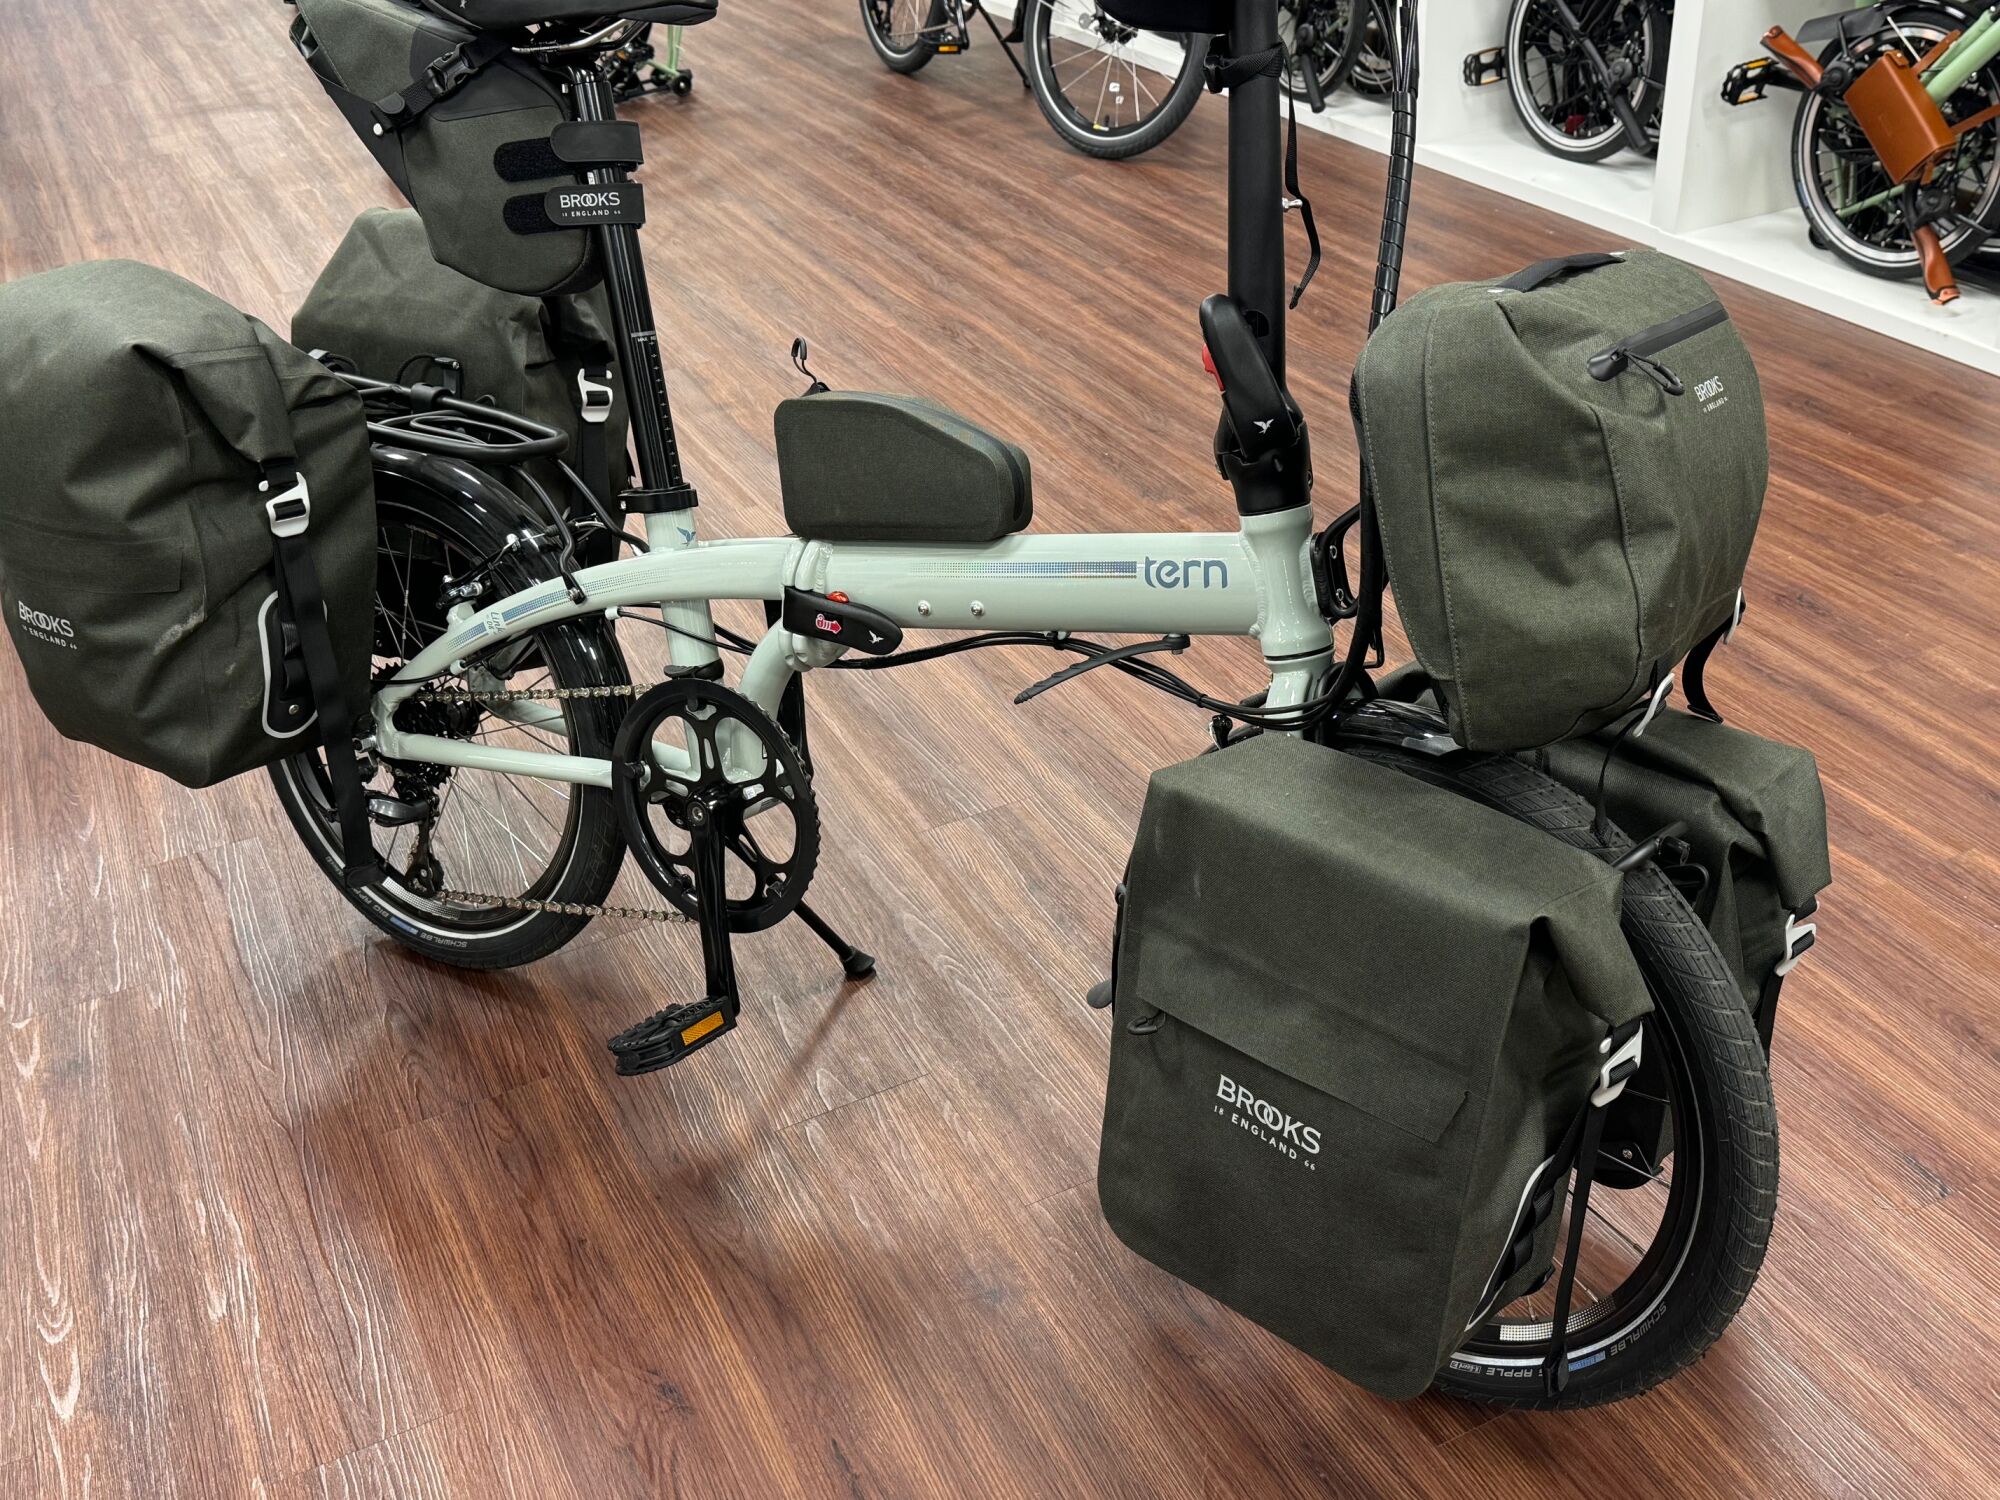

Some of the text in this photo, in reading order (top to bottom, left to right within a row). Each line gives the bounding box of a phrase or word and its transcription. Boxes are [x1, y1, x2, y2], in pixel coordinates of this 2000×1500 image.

[560, 192, 620, 208] BROOKS
[571, 209, 610, 217] ENGLAND
[1693, 375, 1724, 402] BROOKS
[1144, 556, 1228, 589] tern
[18, 600, 74, 637] BROOKS
[491, 611, 506, 633] Link
[29, 627, 67, 647] ENGLAND
[420, 932, 468, 948] SCHWALBE
[1216, 1073, 1322, 1155] BROOKS
[1214, 1105, 1316, 1171] 18 ENGLAND 66
[1610, 1301, 1667, 1357] SCHWALBE
[1485, 1367, 1533, 1378] APPLE
